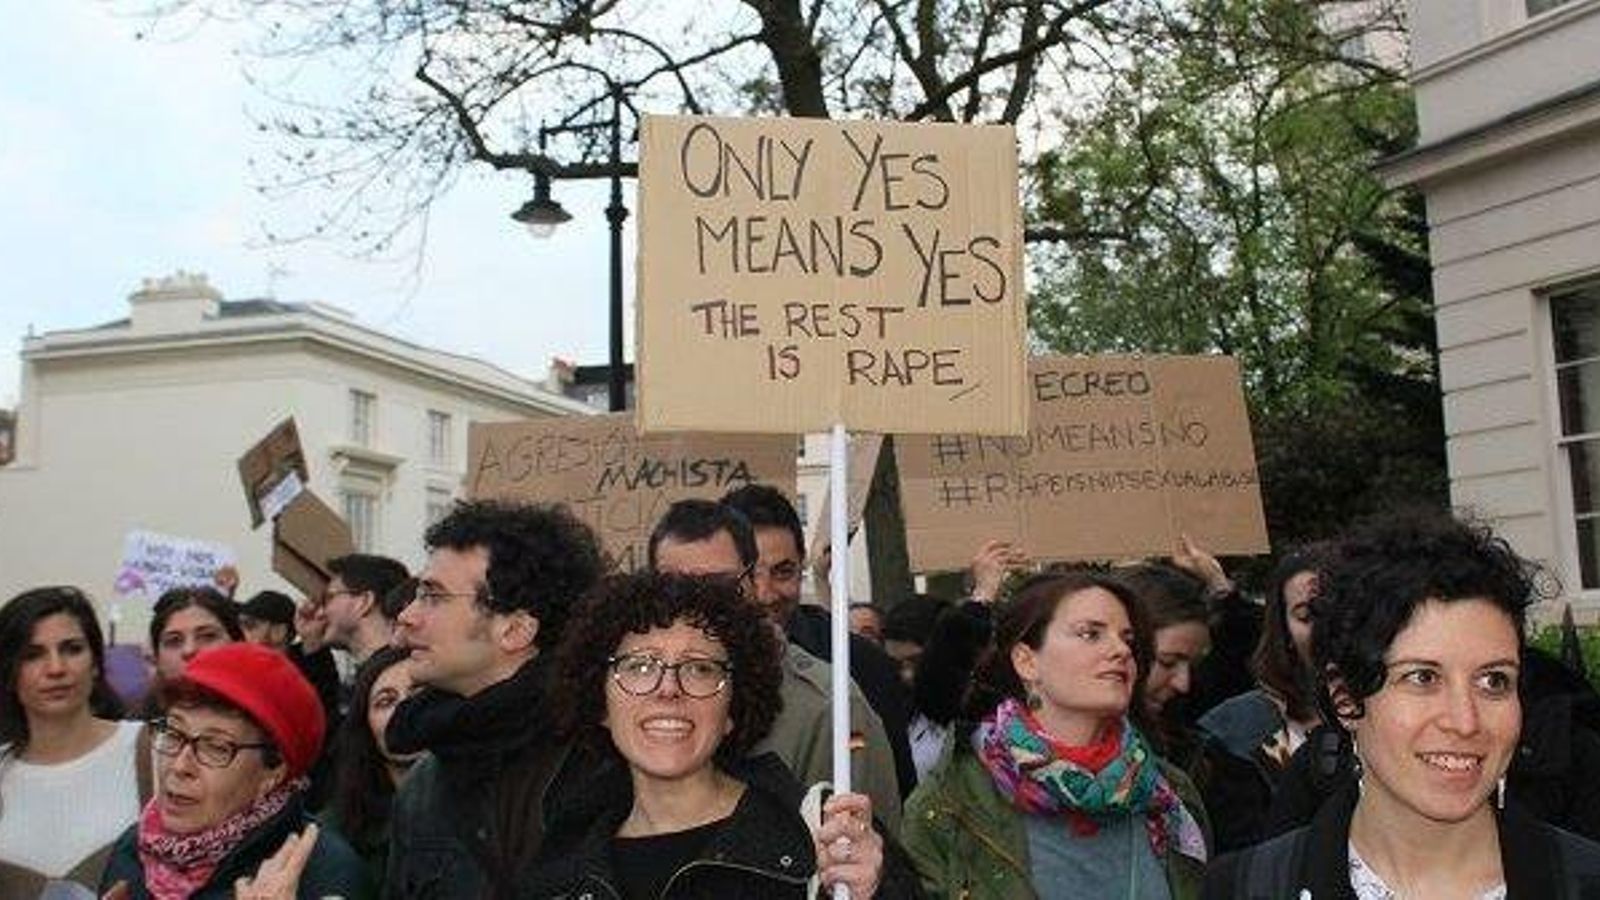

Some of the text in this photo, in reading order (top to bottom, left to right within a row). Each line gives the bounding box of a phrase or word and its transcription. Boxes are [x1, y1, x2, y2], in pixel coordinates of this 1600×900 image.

[681, 122, 949, 211] ONLY YES
[696, 215, 1007, 308] MEANS YES
[691, 300, 904, 339] THE REST
[768, 344, 964, 385] IS RAPE
[597, 458, 753, 491] MACHISTA
